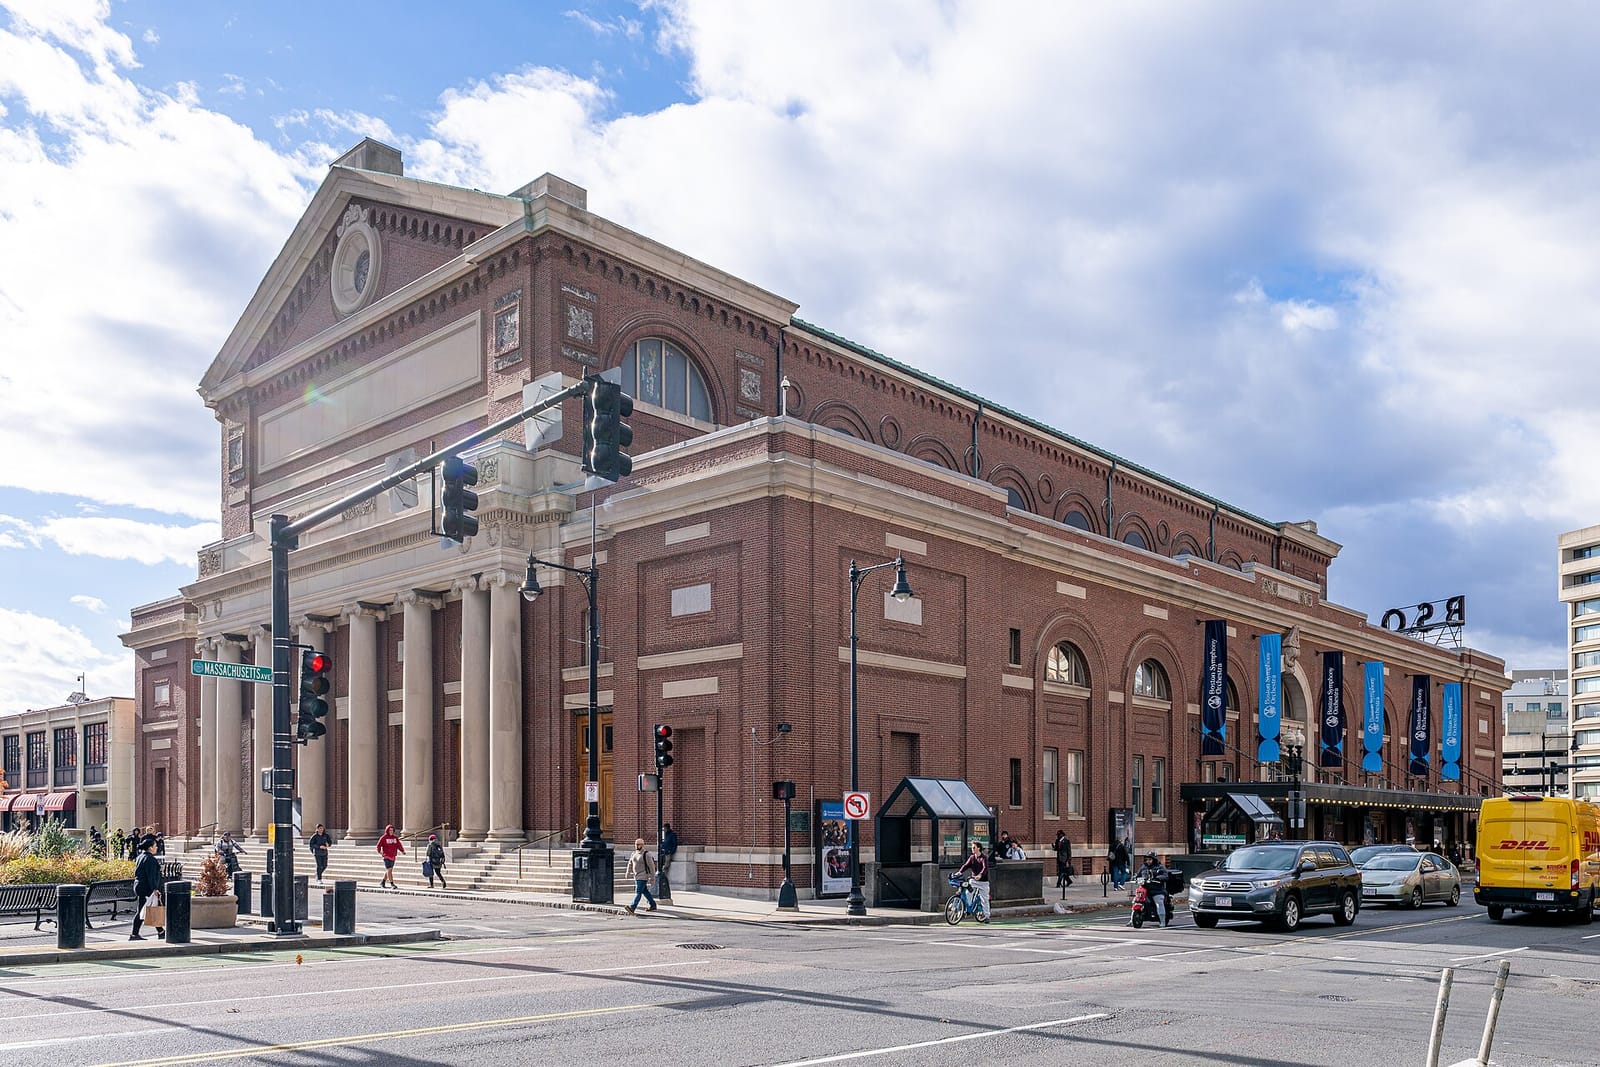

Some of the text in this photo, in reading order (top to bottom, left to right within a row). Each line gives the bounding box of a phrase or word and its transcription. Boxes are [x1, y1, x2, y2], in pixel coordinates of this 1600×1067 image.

[1209, 638, 1217, 671] Symphony
[1264, 652, 1272, 683] Symphony
[204, 662, 261, 680] MASSACHUSETTS
[1327, 667, 1335, 695] Symphony
[1500, 840, 1551, 851] DHL
